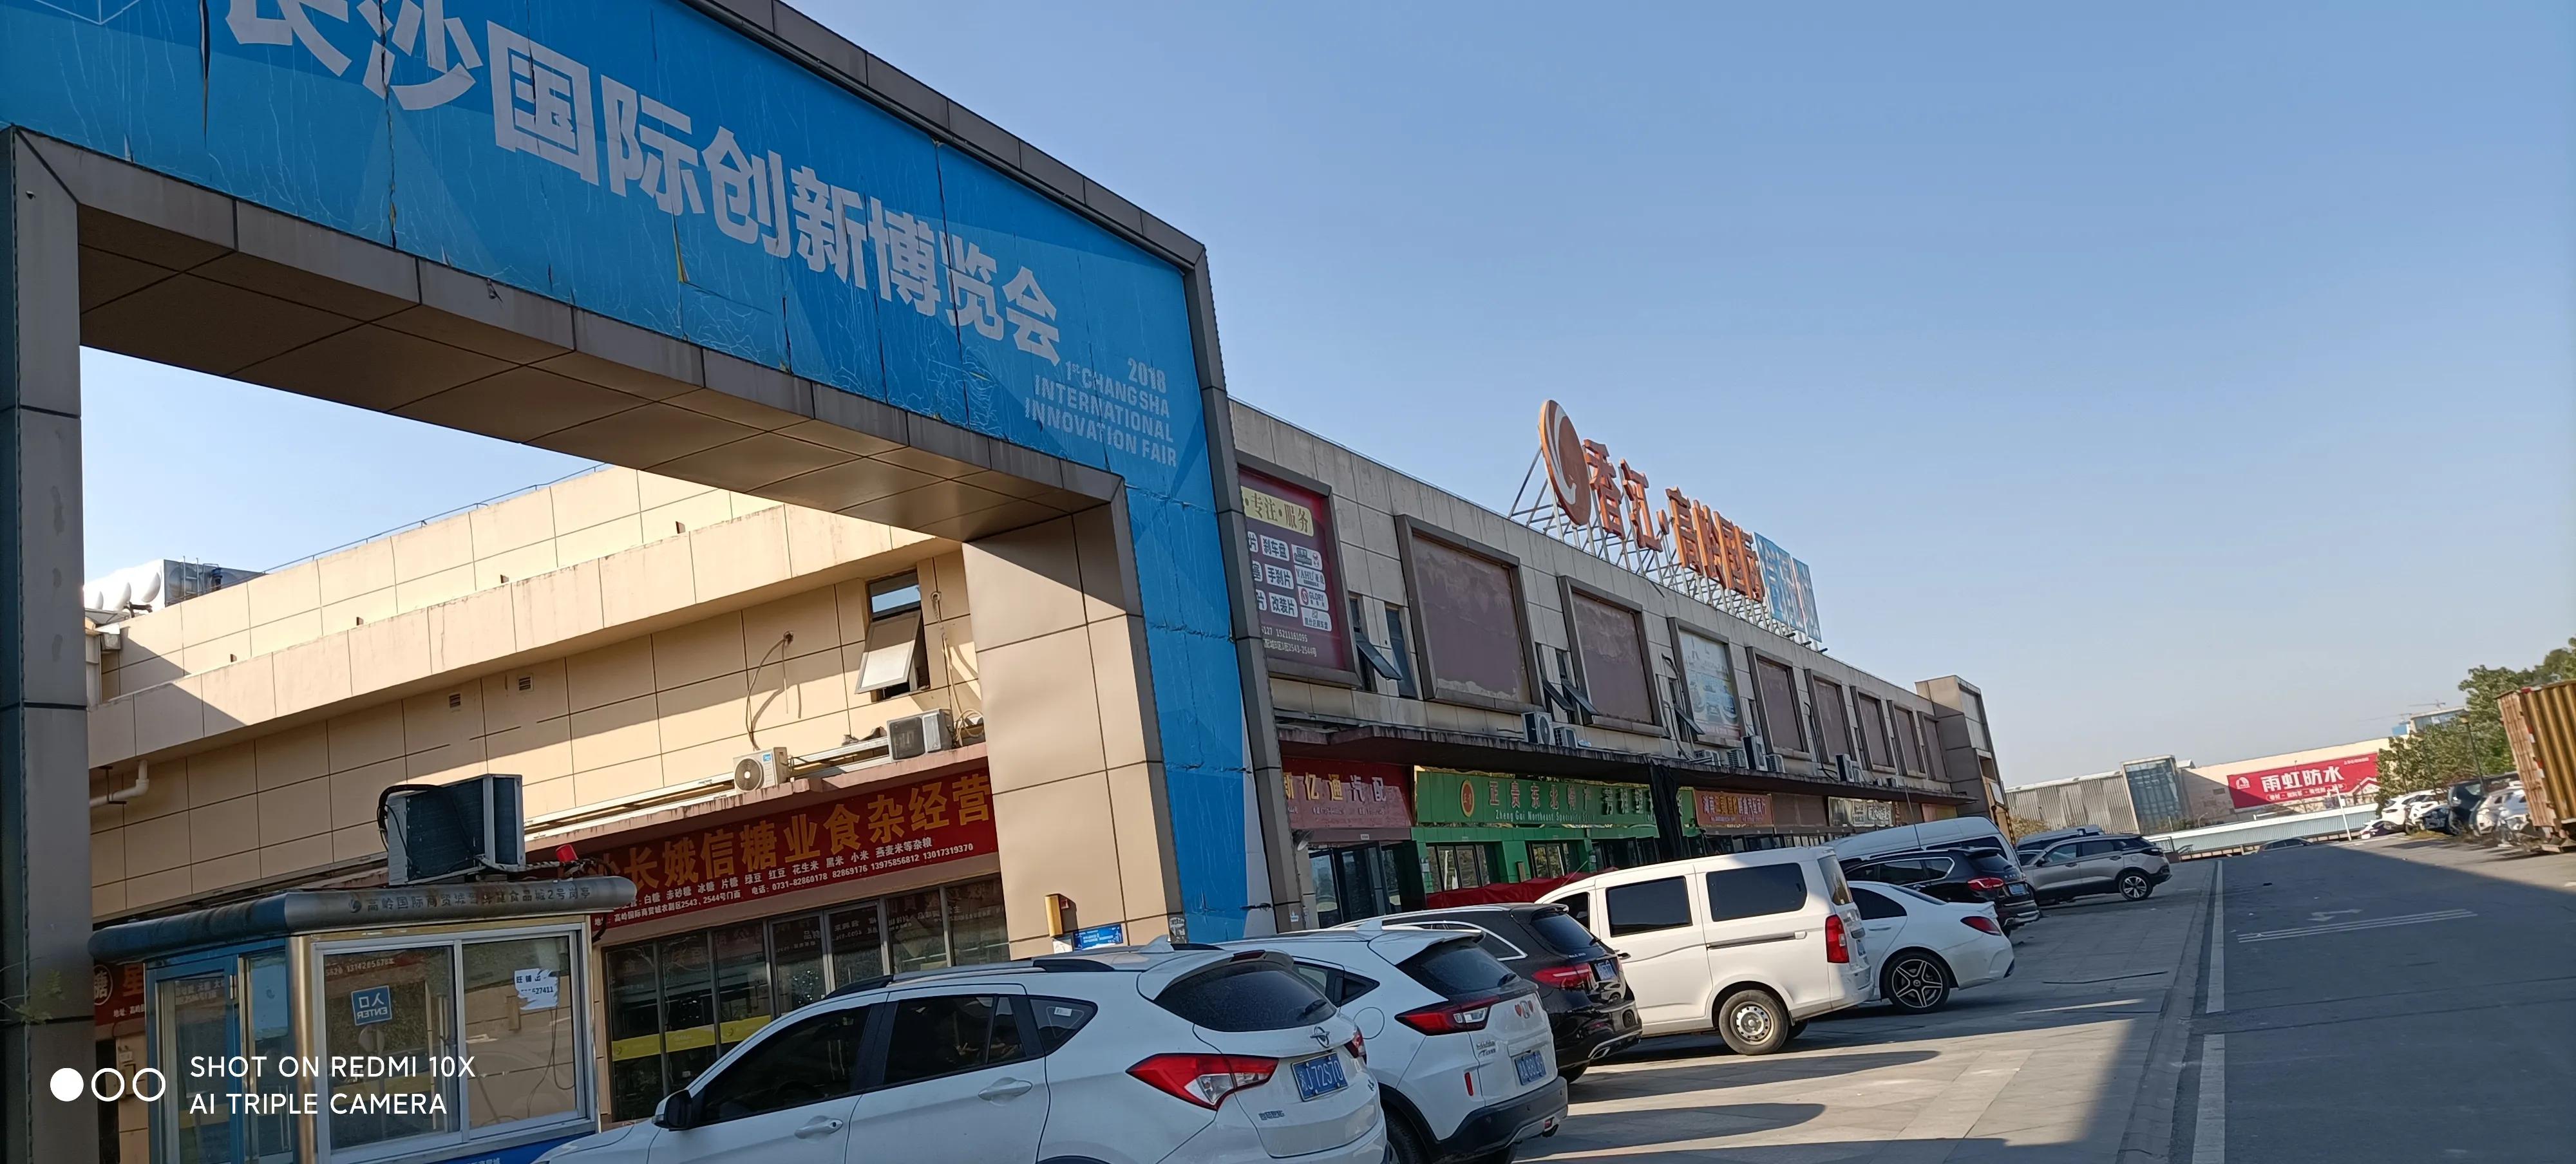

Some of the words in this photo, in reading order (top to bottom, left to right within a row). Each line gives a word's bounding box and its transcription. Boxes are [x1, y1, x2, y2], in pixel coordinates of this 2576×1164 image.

[1081, 368, 1170, 418] CHANGSHA
[1128, 357, 1166, 394] 2018
[1035, 375, 1173, 442] INTERNATIONAL
[1025, 397, 1137, 455] INNOVATION
[1142, 438, 1177, 467] FAIR
[2260, 765, 2345, 793] 雨虹防水
[1495, 810, 1513, 822] Zheng
[1515, 811, 1525, 820] Gui
[697, 881, 715, 894] 冰糖
[721, 876, 739, 890] 片糖
[744, 872, 762, 885] 绿豆
[768, 868, 786, 881] 红豆
[791, 861, 819, 876] 花生米
[851, 850, 869, 863] 小米
